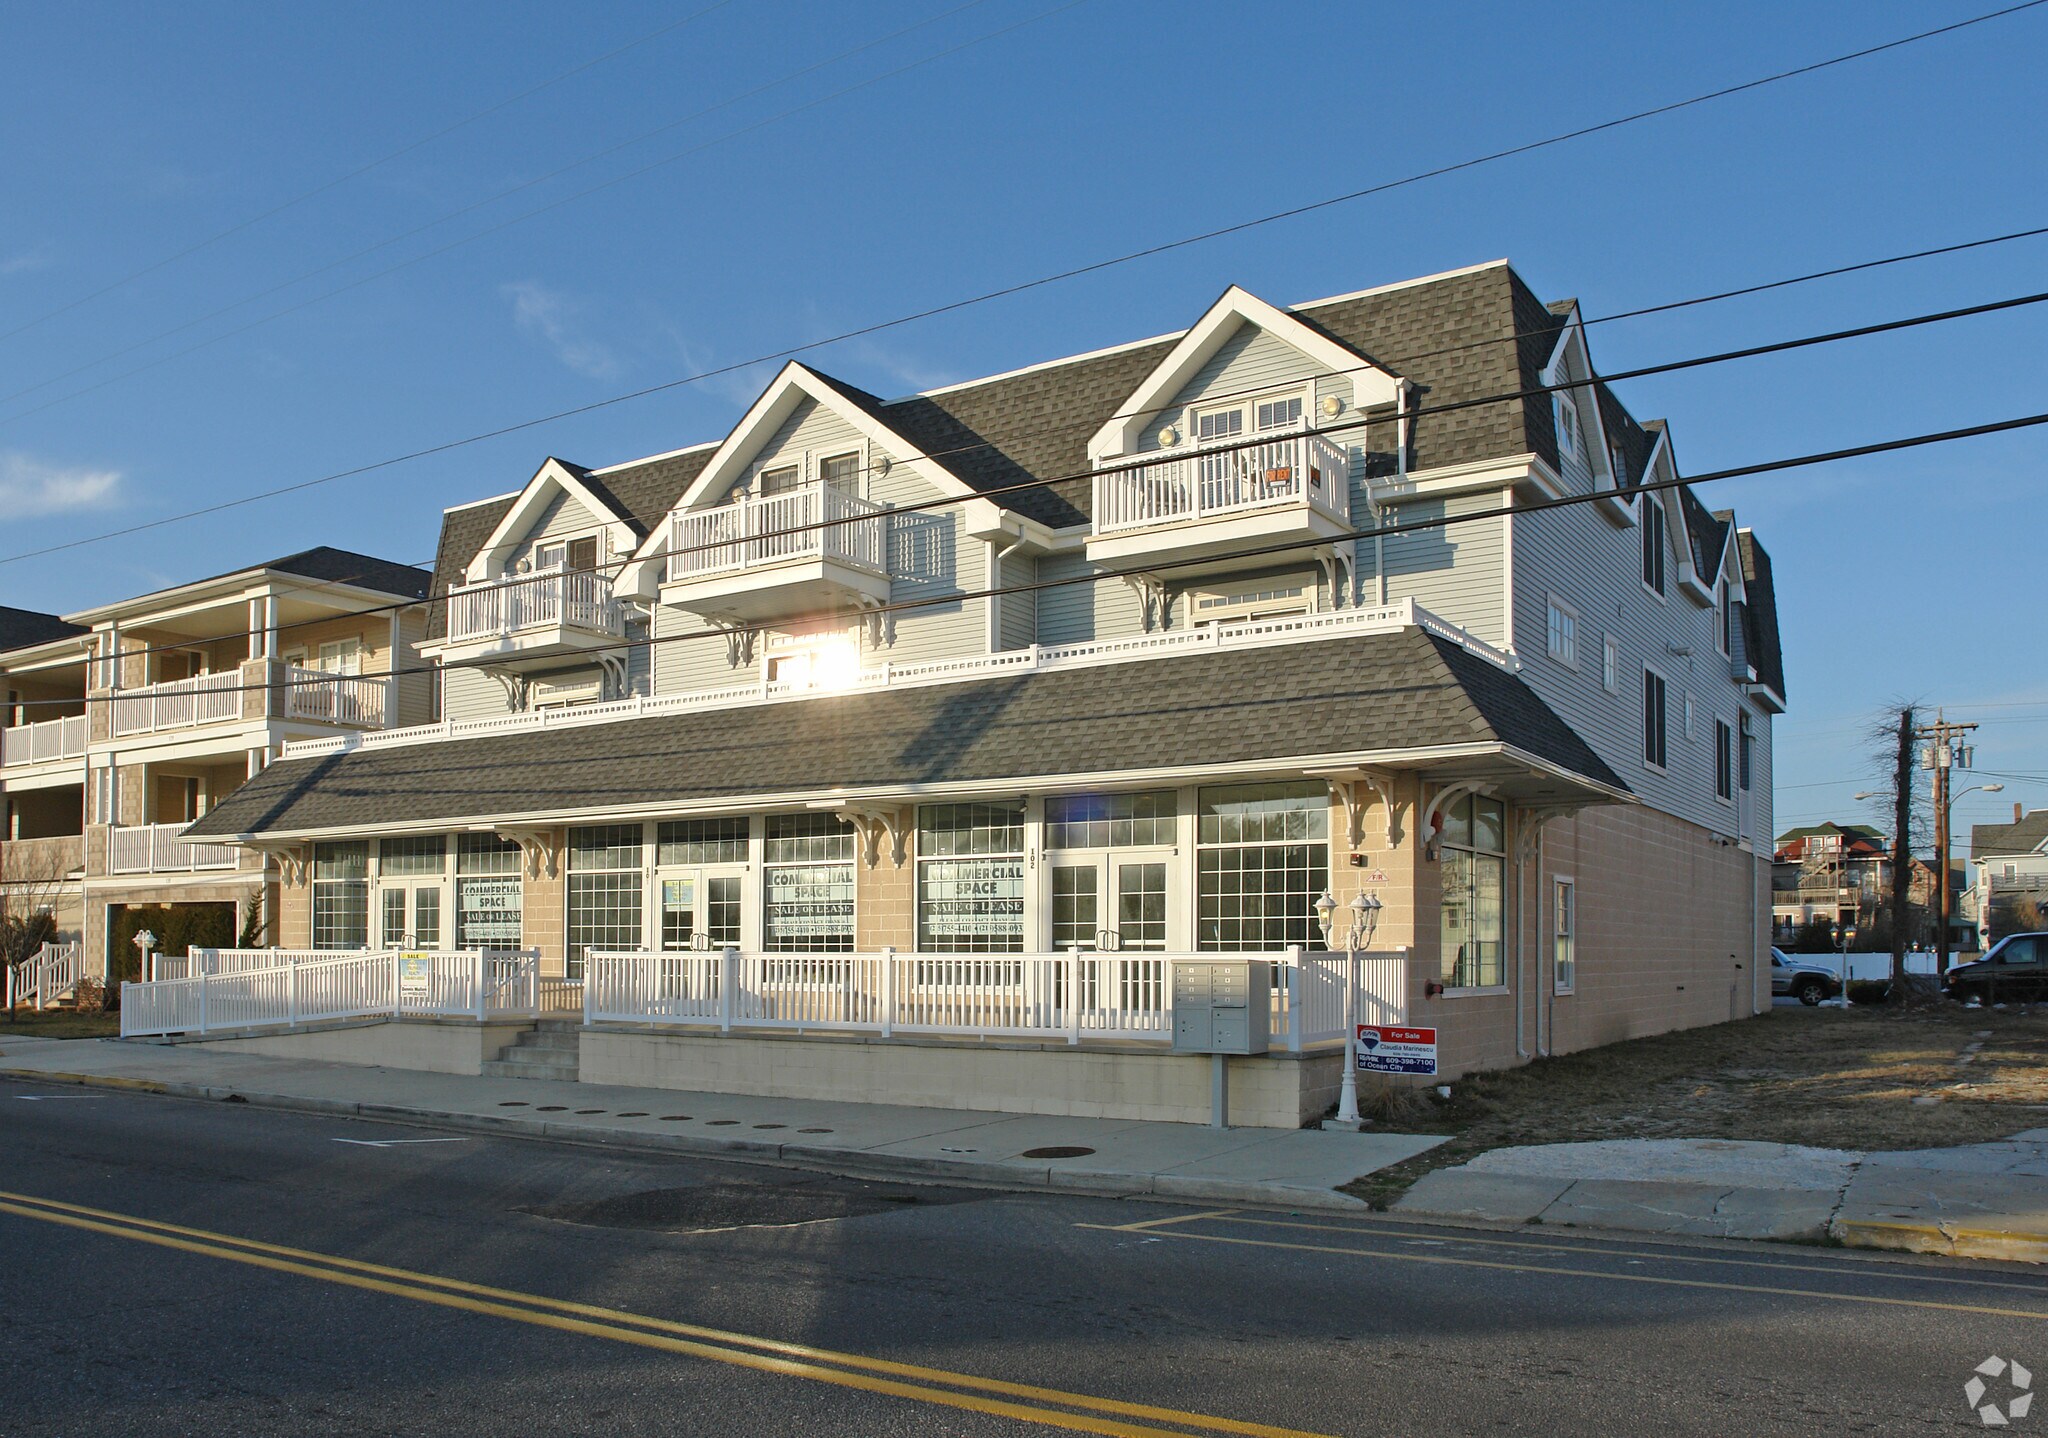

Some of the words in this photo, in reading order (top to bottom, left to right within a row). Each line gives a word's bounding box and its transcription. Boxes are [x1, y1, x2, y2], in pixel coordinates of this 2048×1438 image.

[773, 871, 853, 886] COMIAL
[931, 867, 1024, 880] COMERCIAL
[794, 885, 830, 899] SPACE
[955, 882, 998, 895] SPACE
[479, 897, 506, 908] SPACE
[932, 901, 963, 912] SALE
[965, 902, 979, 911] OR
[981, 900, 1023, 911] LEASE
[774, 905, 801, 916] SALE
[816, 904, 852, 914] LEASE
[466, 912, 486, 921] SALE
[496, 912, 521, 921] LEASE
[1380, 1043, 1402, 1051] Claudia
[1367, 1061, 1388, 1069] Ocean
[1389, 1063, 1404, 1072] City
